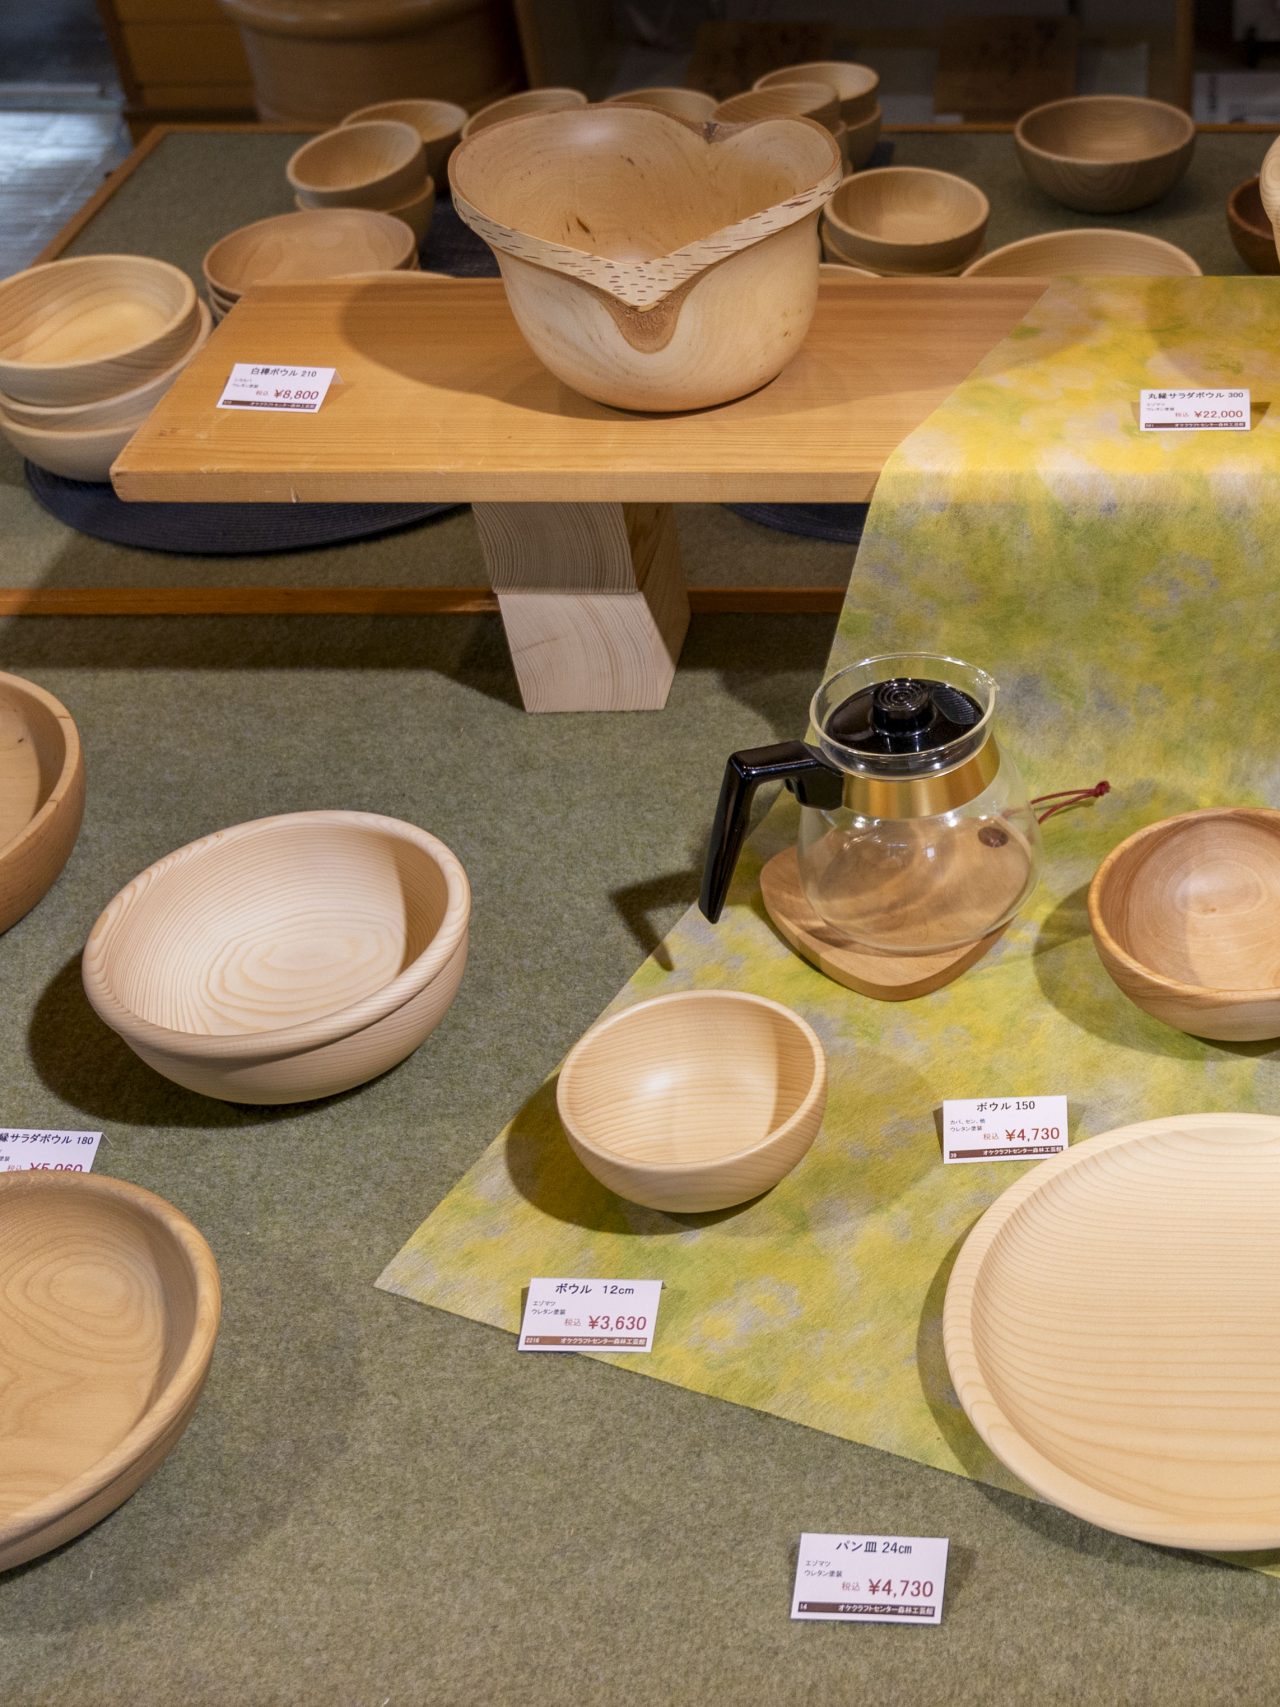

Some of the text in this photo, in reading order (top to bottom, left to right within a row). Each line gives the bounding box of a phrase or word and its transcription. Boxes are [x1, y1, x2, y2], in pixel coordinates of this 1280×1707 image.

[251, 367, 298, 376] 白樺ボウル
[274, 389, 319, 400] ¥8,800
[1194, 410, 1243, 419] ¥22,000
[976, 1101, 1035, 1112] ボウル 150
[1005, 1127, 1060, 1142] ¥4,730
[77, 1136, 94, 1145] 180
[555, 1283, 634, 1295] ボウル 12cm
[564, 1315, 647, 1332] 税込 ¥3,630
[836, 1540, 912, 1554] パン皿 24cm
[842, 1578, 933, 1598] 税込 ¥4,730
